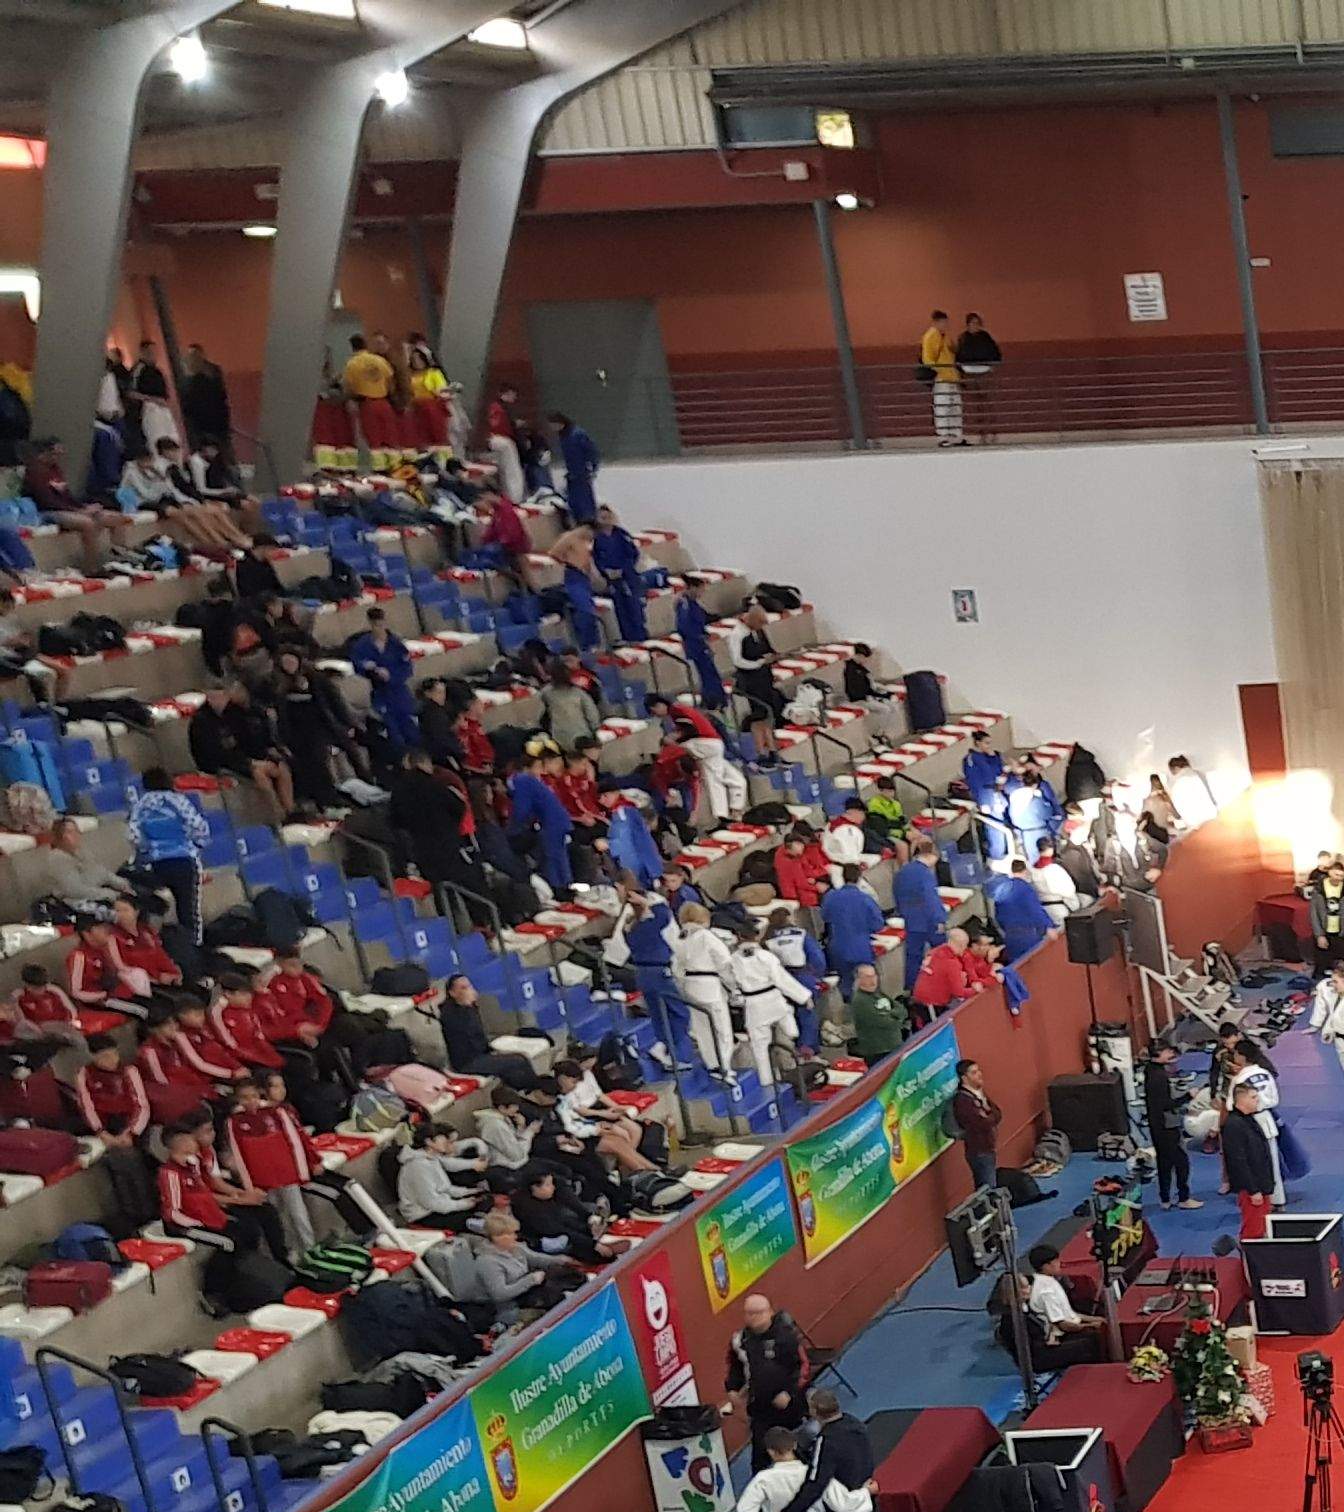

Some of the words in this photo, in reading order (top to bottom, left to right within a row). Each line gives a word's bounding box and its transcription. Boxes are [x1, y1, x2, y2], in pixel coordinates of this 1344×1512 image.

[510, 1370, 548, 1415] Ilustre
[546, 1317, 618, 1384] Ayuntamiento
[521, 1388, 580, 1452] Granadilla
[578, 1380, 593, 1406] de
